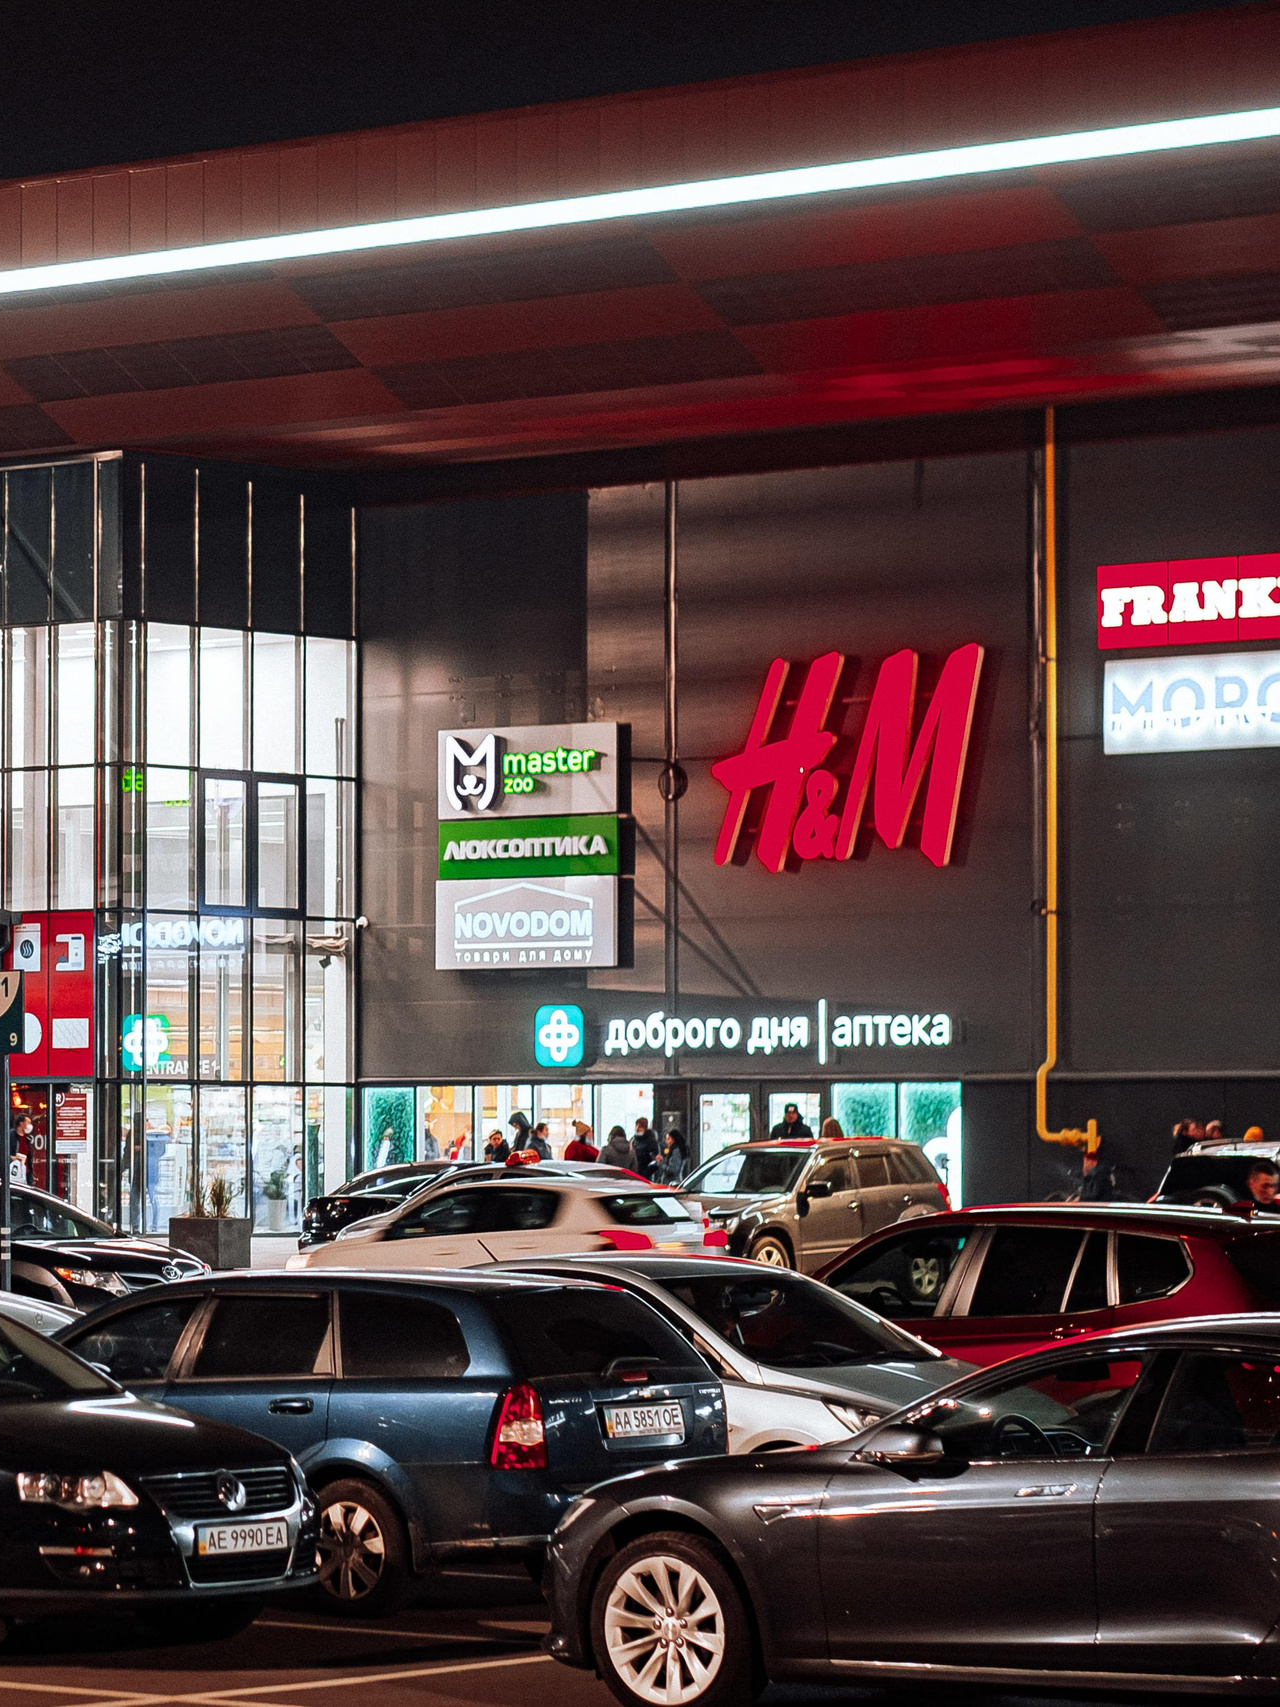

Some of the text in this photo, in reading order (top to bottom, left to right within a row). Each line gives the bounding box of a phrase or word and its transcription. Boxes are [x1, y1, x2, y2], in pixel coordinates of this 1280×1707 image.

[1101, 576, 1280, 628] FRANK
[503, 746, 595, 775] master
[712, 643, 984, 872] H&M
[504, 777, 534, 794] zoo
[444, 835, 608, 861] ЛЮКСОПТИКА
[454, 909, 593, 939] NOVODOM
[518, 950, 546, 963] для
[553, 949, 593, 963] дому
[9, 1032, 18, 1047] 9
[604, 1011, 952, 1058] доброго дня аптека
[614, 1407, 681, 1431] AA 5851 OE
[208, 1526, 284, 1550] AE 9990 EA
